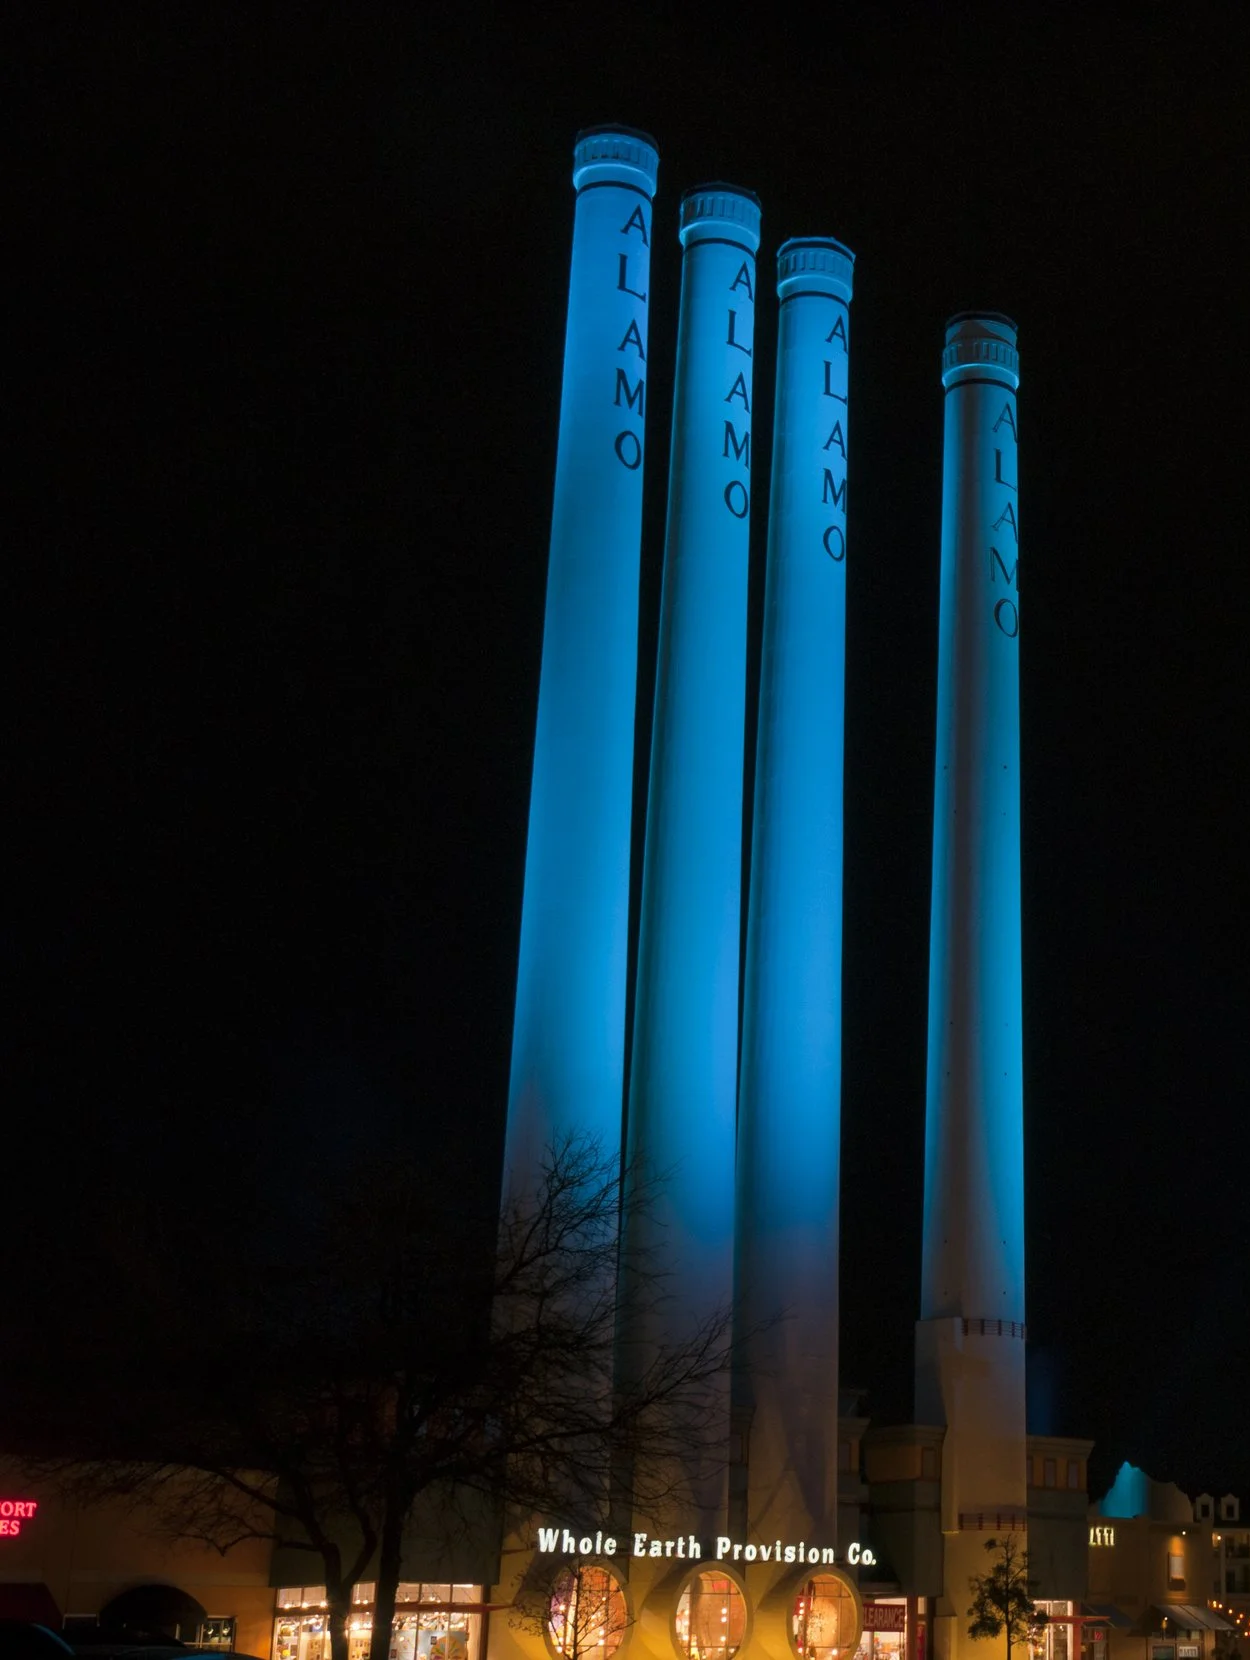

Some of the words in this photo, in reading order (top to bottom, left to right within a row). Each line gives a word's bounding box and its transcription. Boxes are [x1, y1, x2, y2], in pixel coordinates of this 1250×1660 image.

[613, 203, 650, 470] ALAMO
[722, 260, 754, 519] ALAMO
[821, 314, 848, 562] ALAMO
[0, 1501, 37, 1518] ORT
[538, 1527, 617, 1555] Whole
[633, 1533, 701, 1559] Earth
[716, 1536, 834, 1564] Provision
[848, 1542, 877, 1565] Co.
